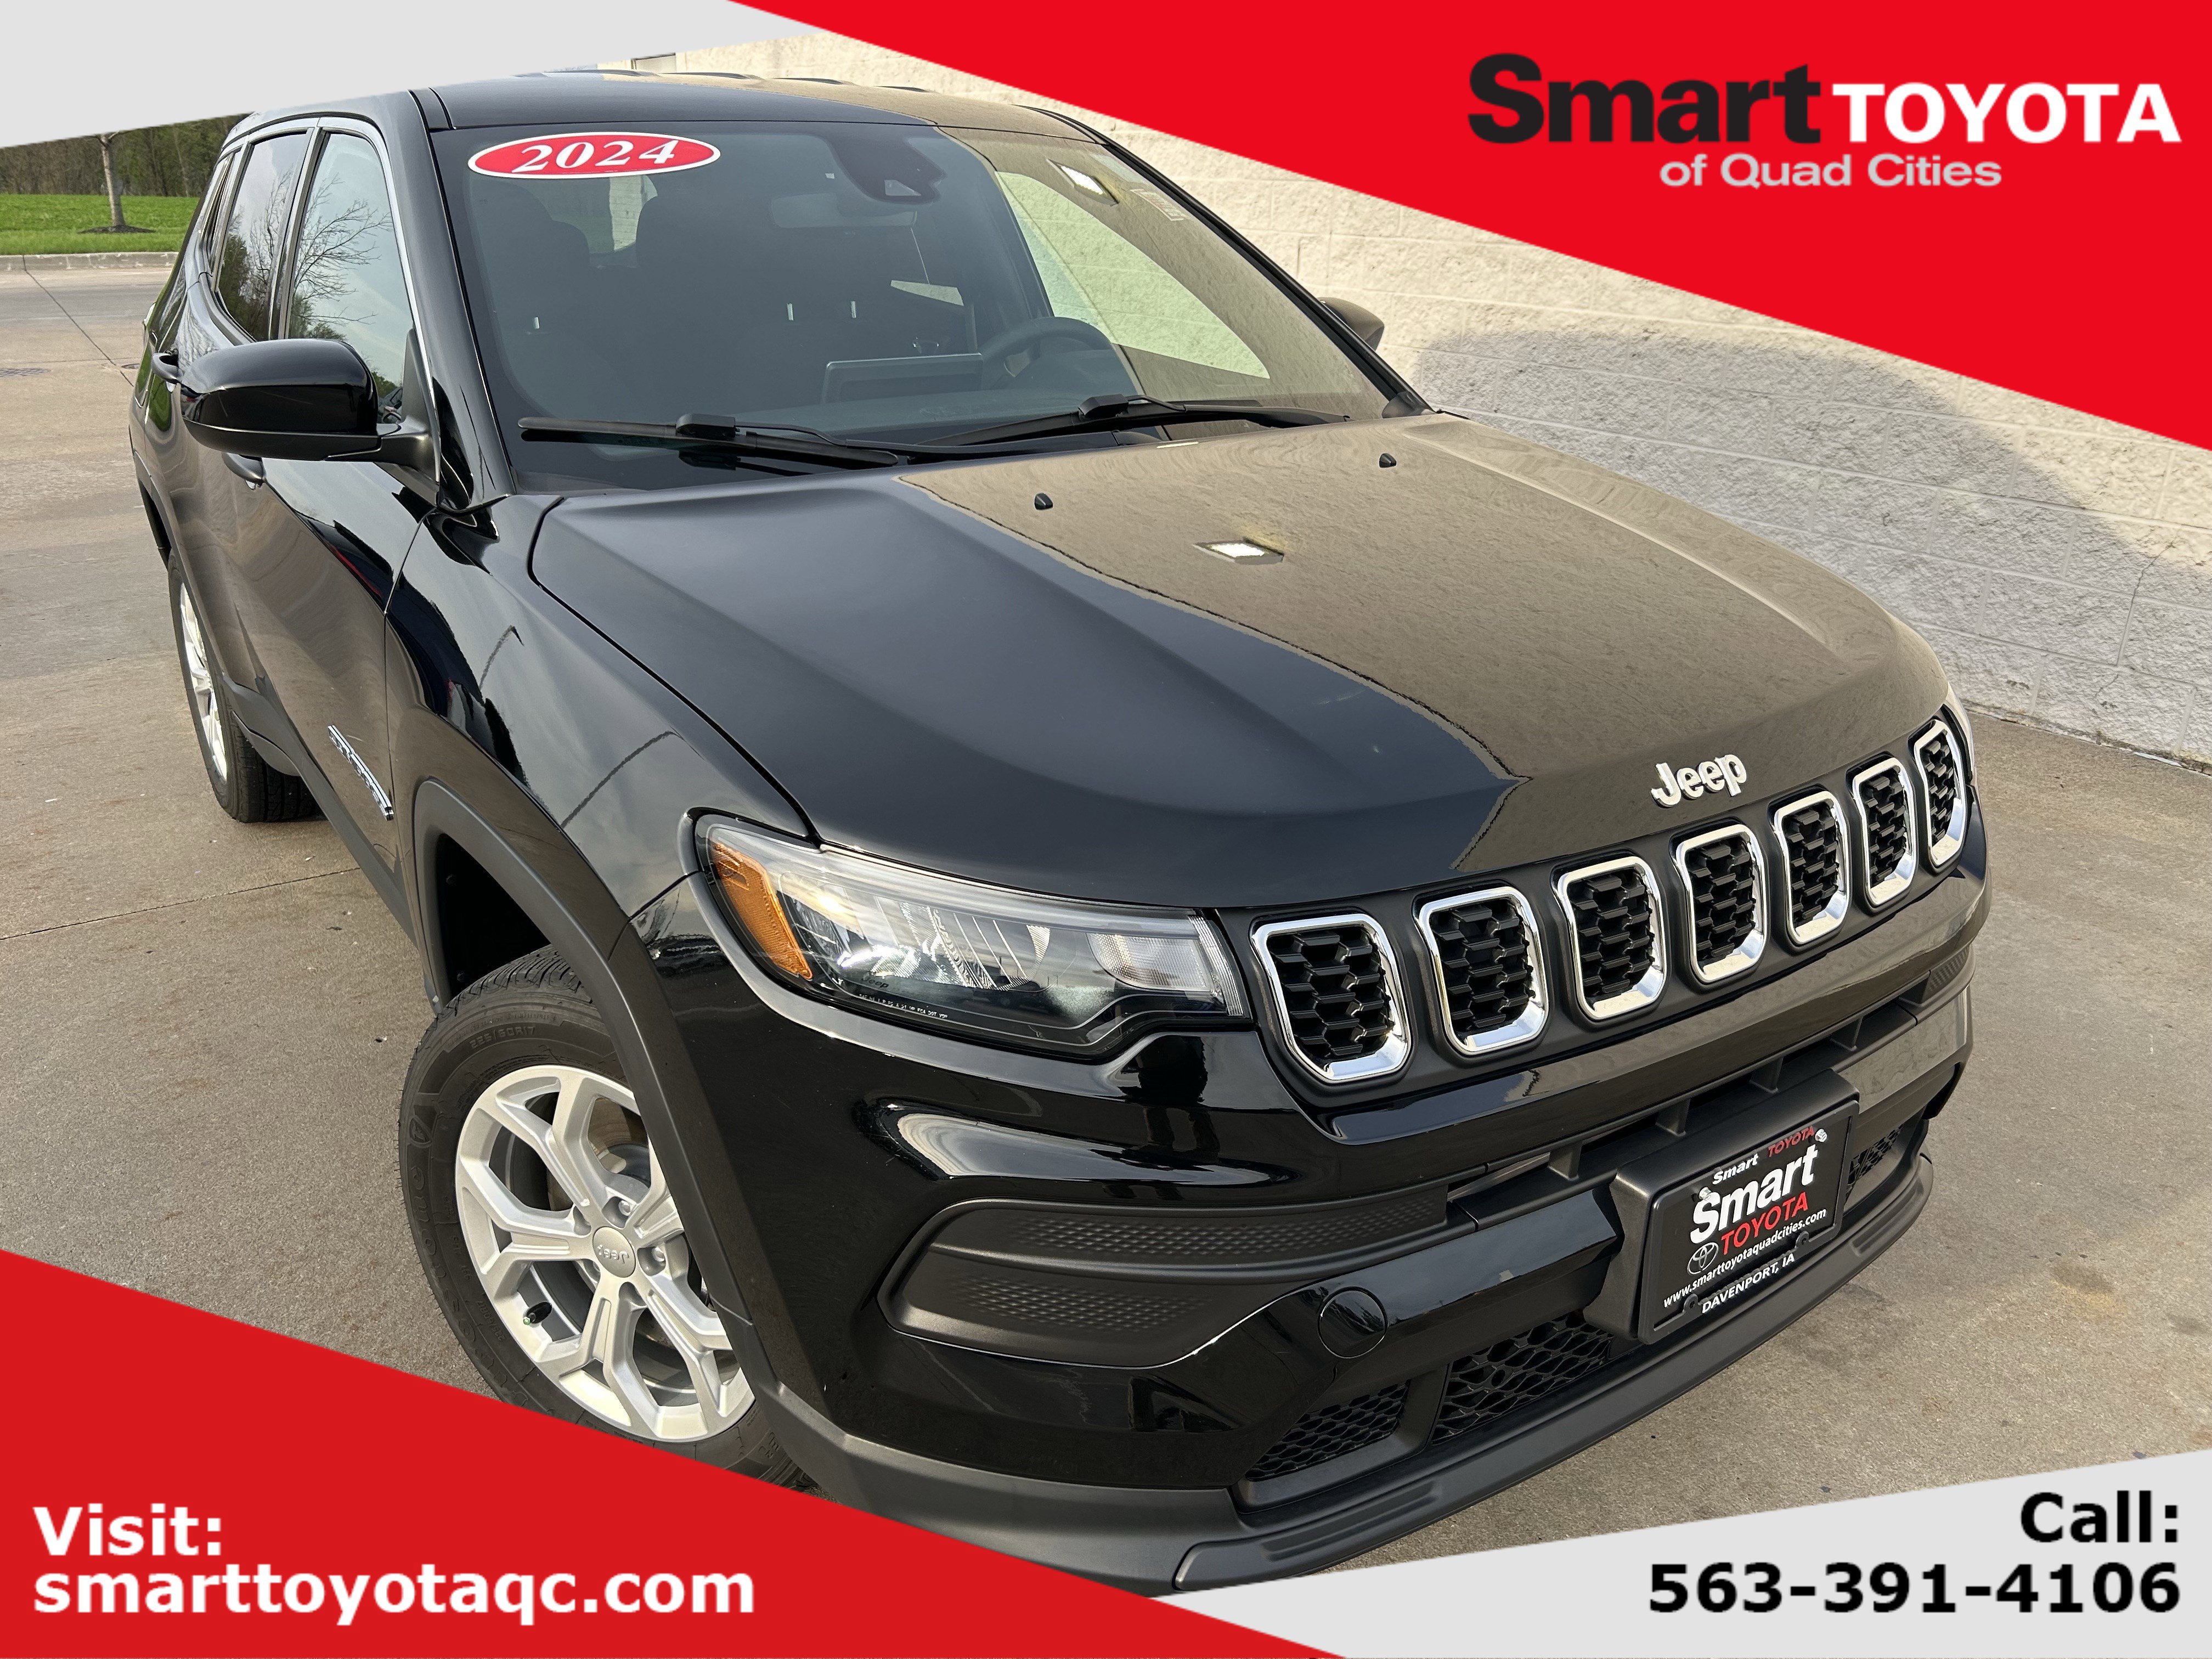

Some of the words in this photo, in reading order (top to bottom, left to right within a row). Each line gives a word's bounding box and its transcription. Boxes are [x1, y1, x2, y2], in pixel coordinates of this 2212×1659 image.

[511, 140, 679, 173] 2024
[1651, 754, 1747, 808] Jeep
[1712, 1153, 1759, 1184] Smart
[1768, 1125, 1815, 1158] TOYOTA
[1690, 1144, 1819, 1244] Smart
[1720, 1191, 1809, 1256] TOYOTA
[597, 1244, 630, 1264] Jeep
[1663, 1209, 1827, 1308] www.smarttoyotaquadcities.com
[1702, 1262, 1779, 1314] DAVENPORT,
[1782, 1253, 1795, 1267] IA
